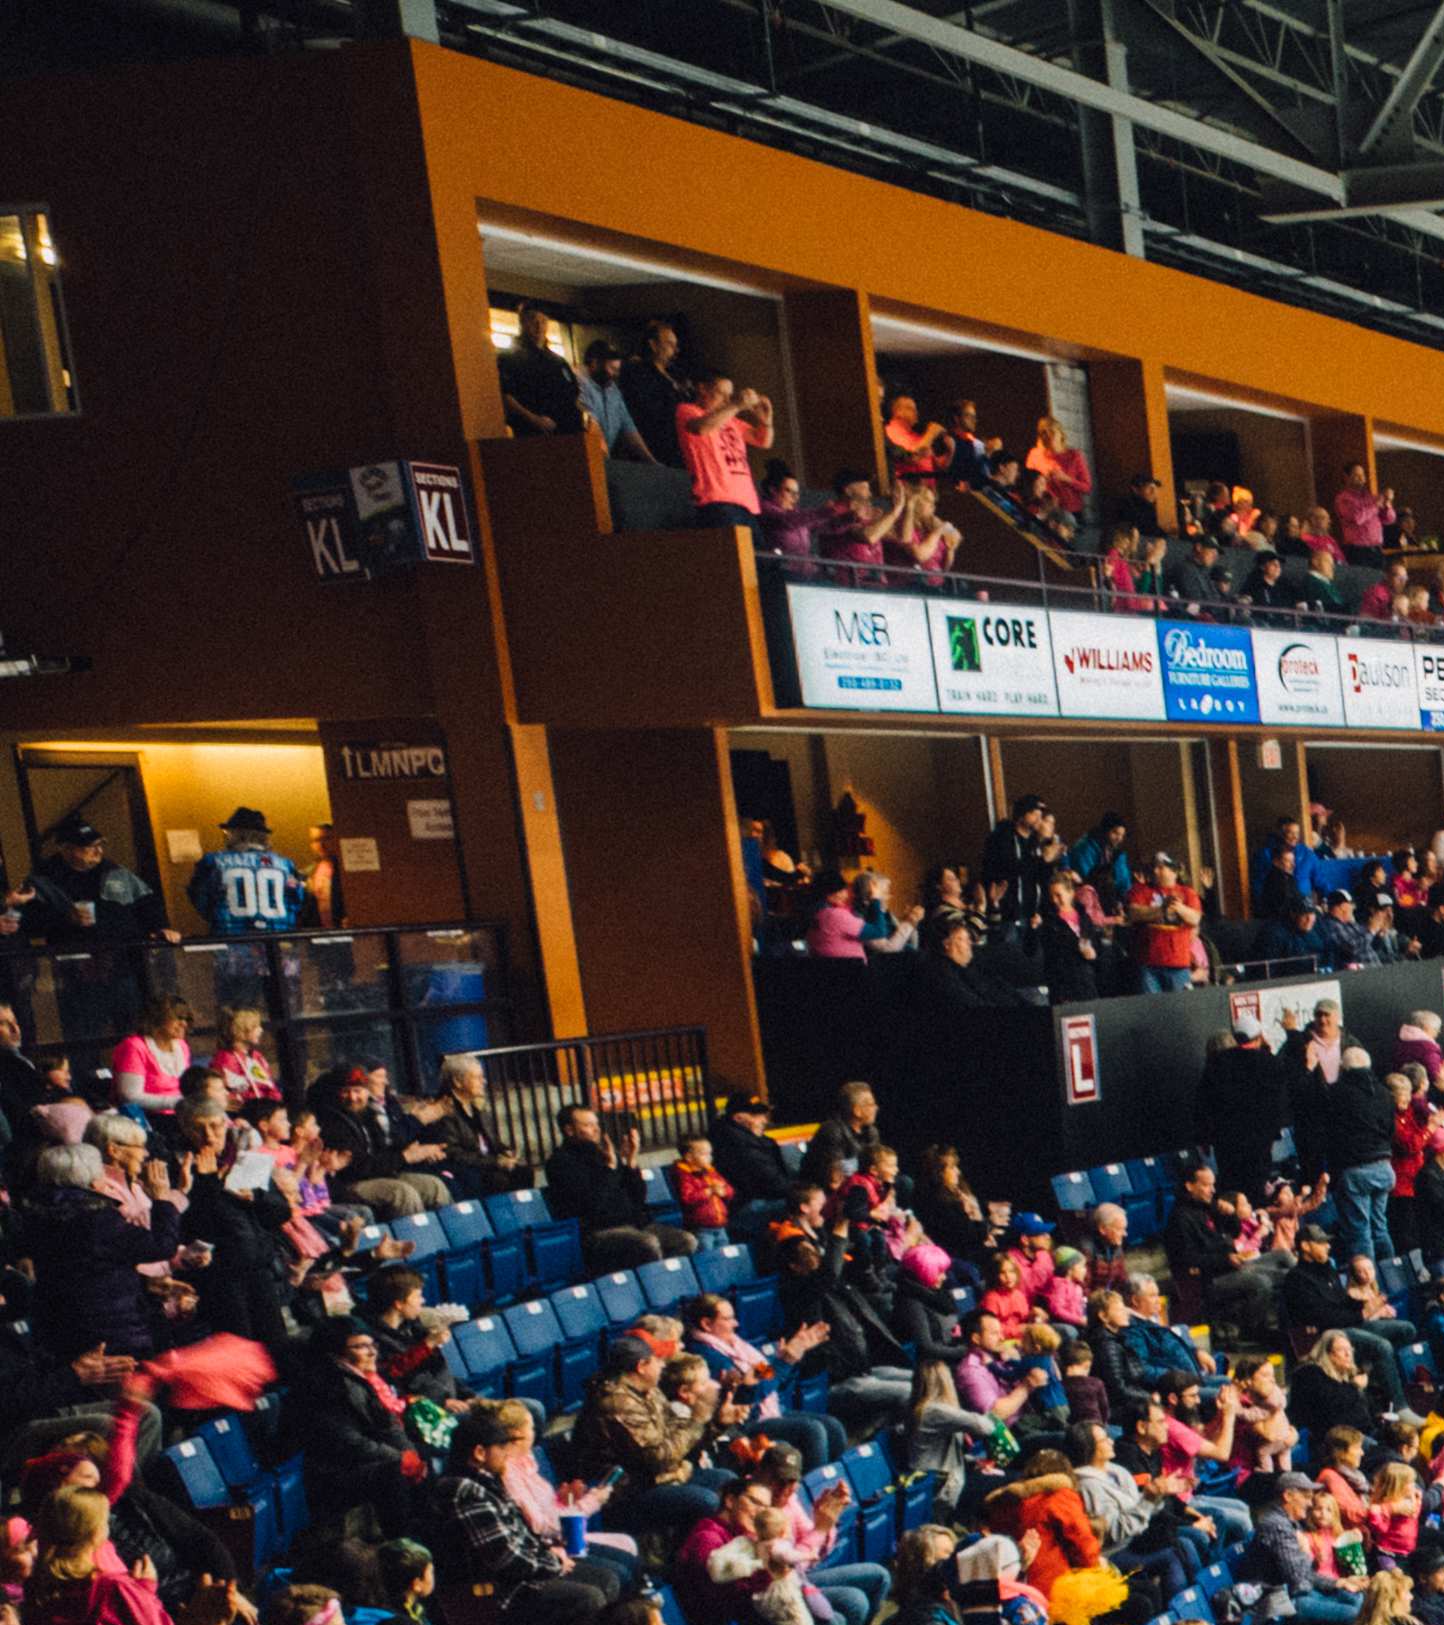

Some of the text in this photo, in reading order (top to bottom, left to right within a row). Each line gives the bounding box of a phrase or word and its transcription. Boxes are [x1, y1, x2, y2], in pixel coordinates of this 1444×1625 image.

[414, 472, 458, 488] SECTIONS
[420, 490, 470, 552] KL
[306, 517, 360, 576] KL
[983, 617, 1037, 649] CORE
[1165, 628, 1249, 671] Bedroom
[1078, 647, 1153, 674] WILLIAMS
[357, 747, 446, 778] LMNPQ
[223, 867, 287, 919] 00
[1072, 1043, 1095, 1092] L
